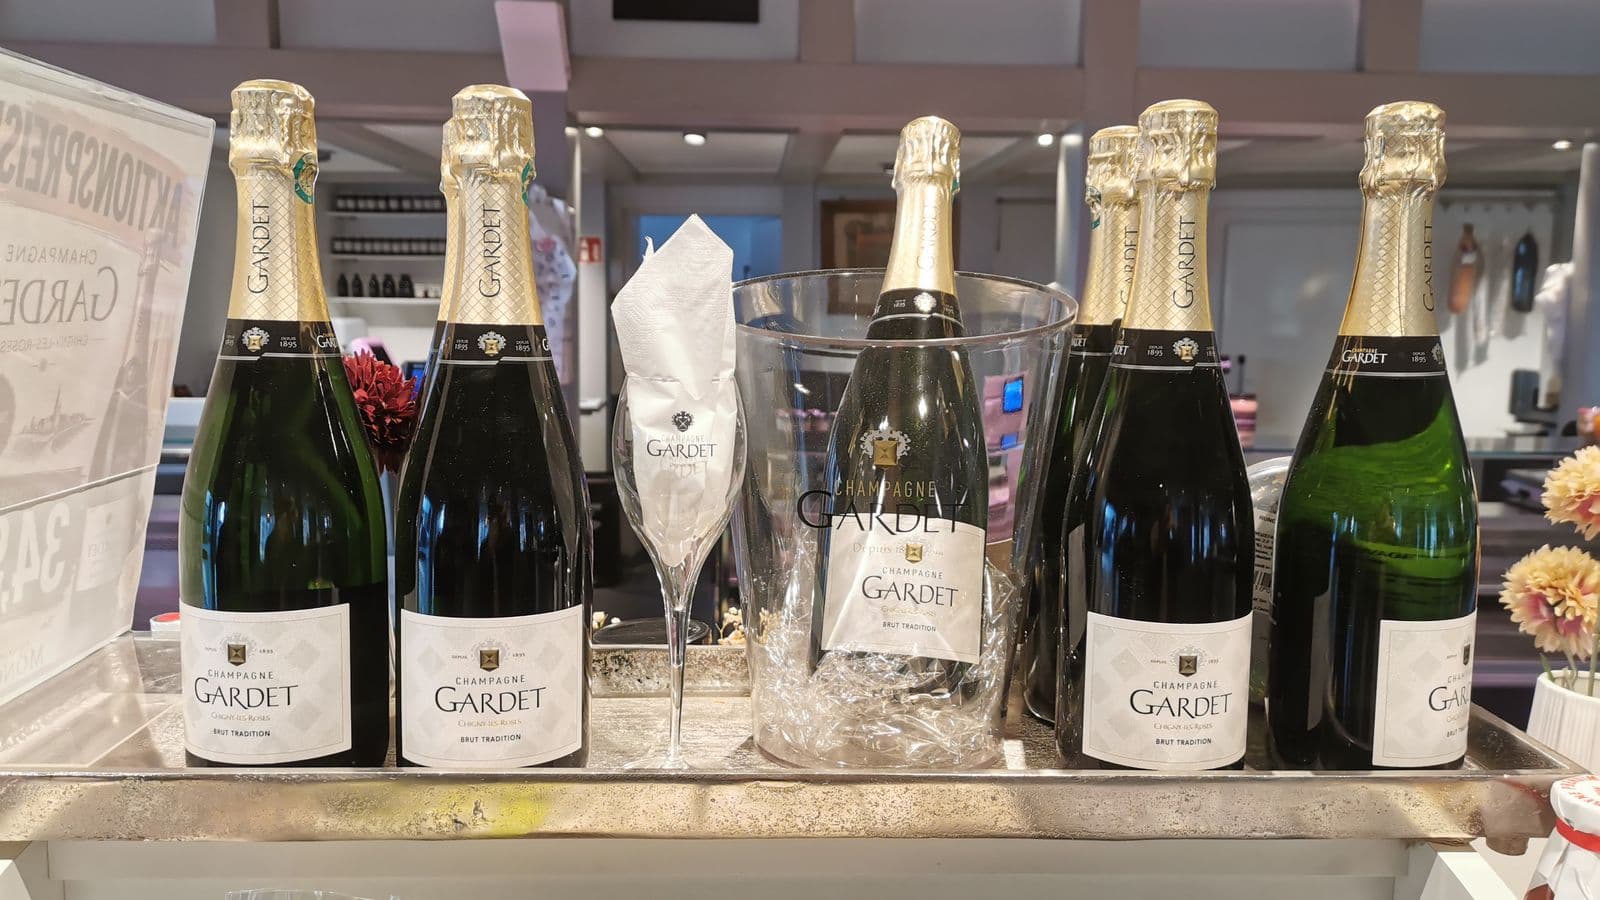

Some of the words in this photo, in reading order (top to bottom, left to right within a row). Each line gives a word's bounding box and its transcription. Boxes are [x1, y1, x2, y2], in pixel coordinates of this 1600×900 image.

[247, 200, 272, 294] GARDET
[479, 203, 503, 298] GARDET
[1173, 215, 1196, 309] GARDET
[280, 340, 297, 348] 1895
[454, 343, 469, 351] 1895
[515, 344, 531, 352] 1895
[1147, 349, 1163, 357] 1895
[1342, 349, 1389, 364] GARDET
[1411, 355, 1427, 363] 1895
[646, 439, 717, 459] GARDET
[834, 479, 937, 498] CHAMPAGNE
[797, 489, 969, 535] GARDET
[882, 567, 943, 580] CHAMPAGNE
[862, 575, 959, 607] GARDET
[882, 621, 899, 629] BRUT
[901, 622, 937, 632] TRADITION
[207, 669, 274, 680] CHAMPAGNE
[455, 674, 526, 685] CHAMPAGNE
[1153, 680, 1218, 690] CHAMPAGNE
[194, 677, 299, 709] GARDET
[1428, 686, 1470, 711] GAR
[434, 686, 547, 714] GARDET
[1130, 689, 1233, 719] GARDET
[213, 728, 229, 736] BRUT
[231, 729, 271, 737] TRADITION
[481, 733, 521, 742] TRADITION
[1176, 737, 1212, 745] TRADITION
